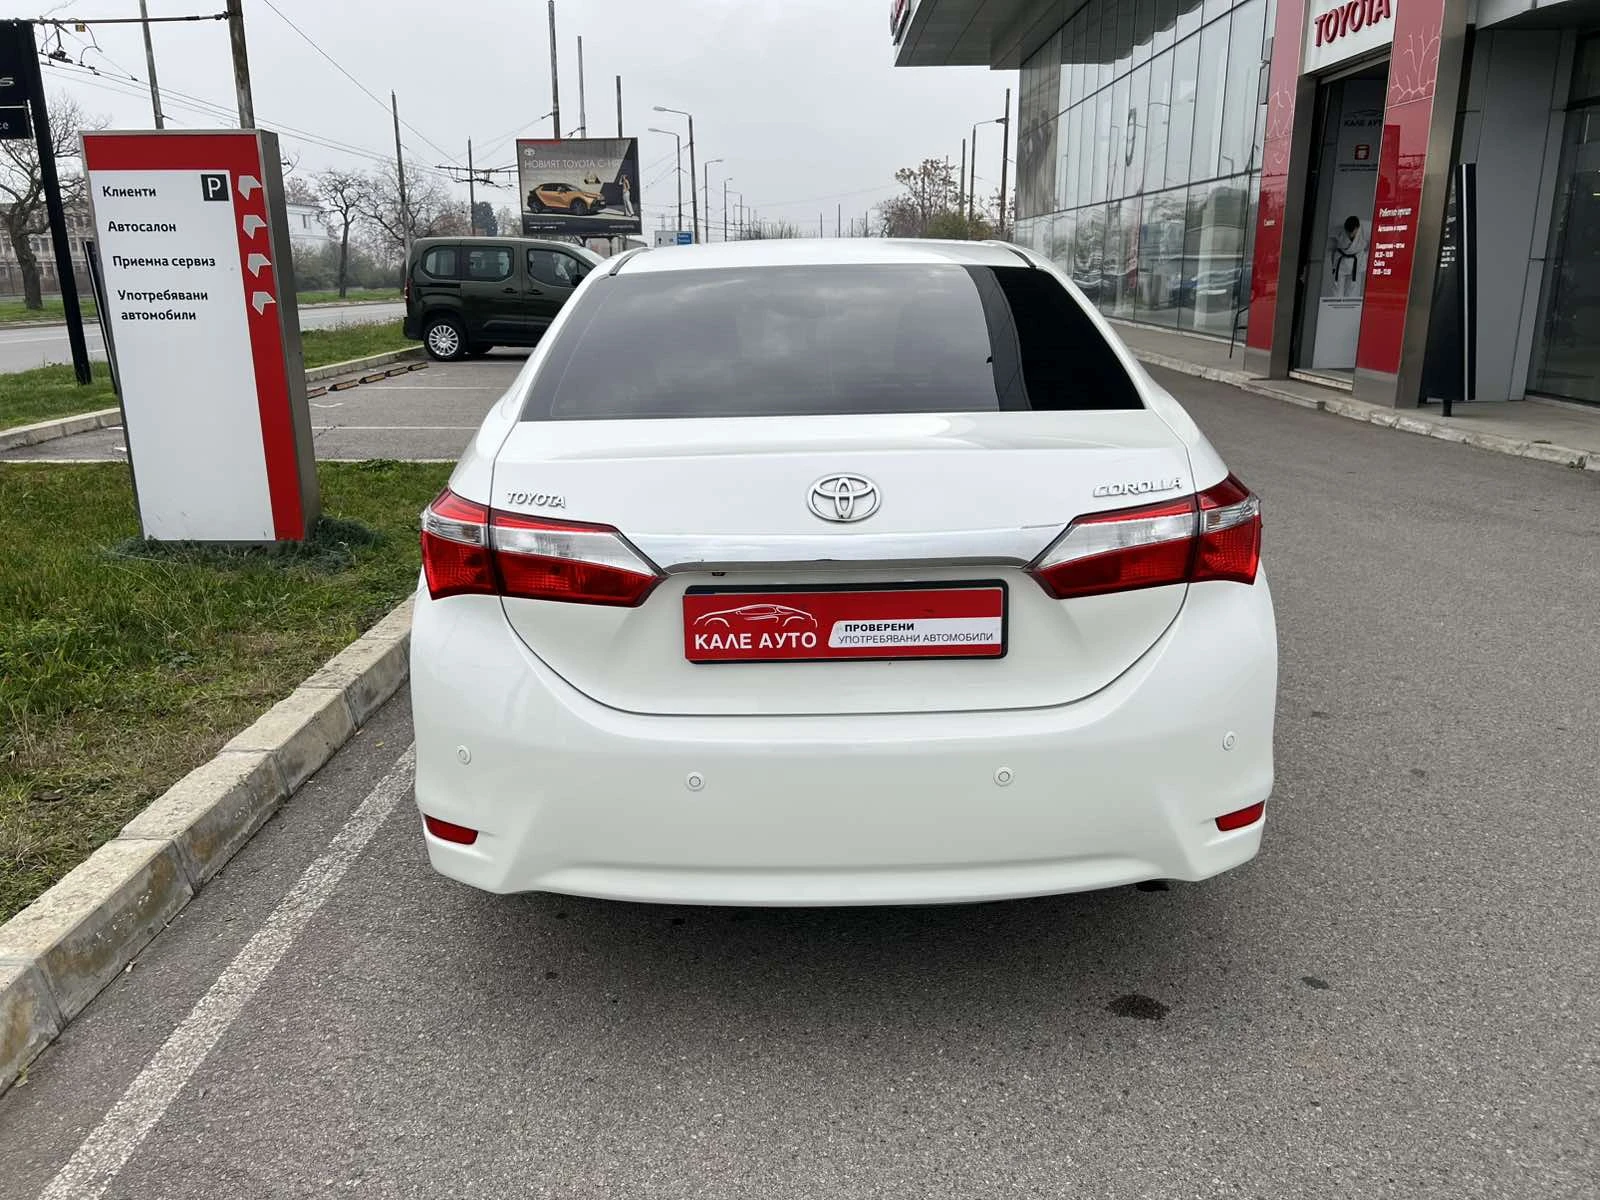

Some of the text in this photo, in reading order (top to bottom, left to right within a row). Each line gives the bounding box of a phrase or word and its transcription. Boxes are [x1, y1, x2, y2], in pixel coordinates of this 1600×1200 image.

[1314, 0, 1391, 47] TOYOTA
[524, 159, 560, 169] НОВИЯТ
[562, 159, 597, 169] TOYOTA
[102, 177, 222, 199] Клиенти P
[108, 220, 177, 233] Автосалон
[112, 255, 216, 269] Приемна сервиз
[117, 289, 209, 303] Употребявани
[121, 308, 197, 321] автомобили
[1093, 477, 1182, 498] COROLLA
[507, 490, 567, 509] TOYOTA
[844, 623, 915, 633] ПРОВЕРЕНИ
[694, 631, 817, 650] КАЛЕ АУТО
[838, 632, 994, 645] УПОТРЕБЯВАНИ АВТОМОБИЛИ
